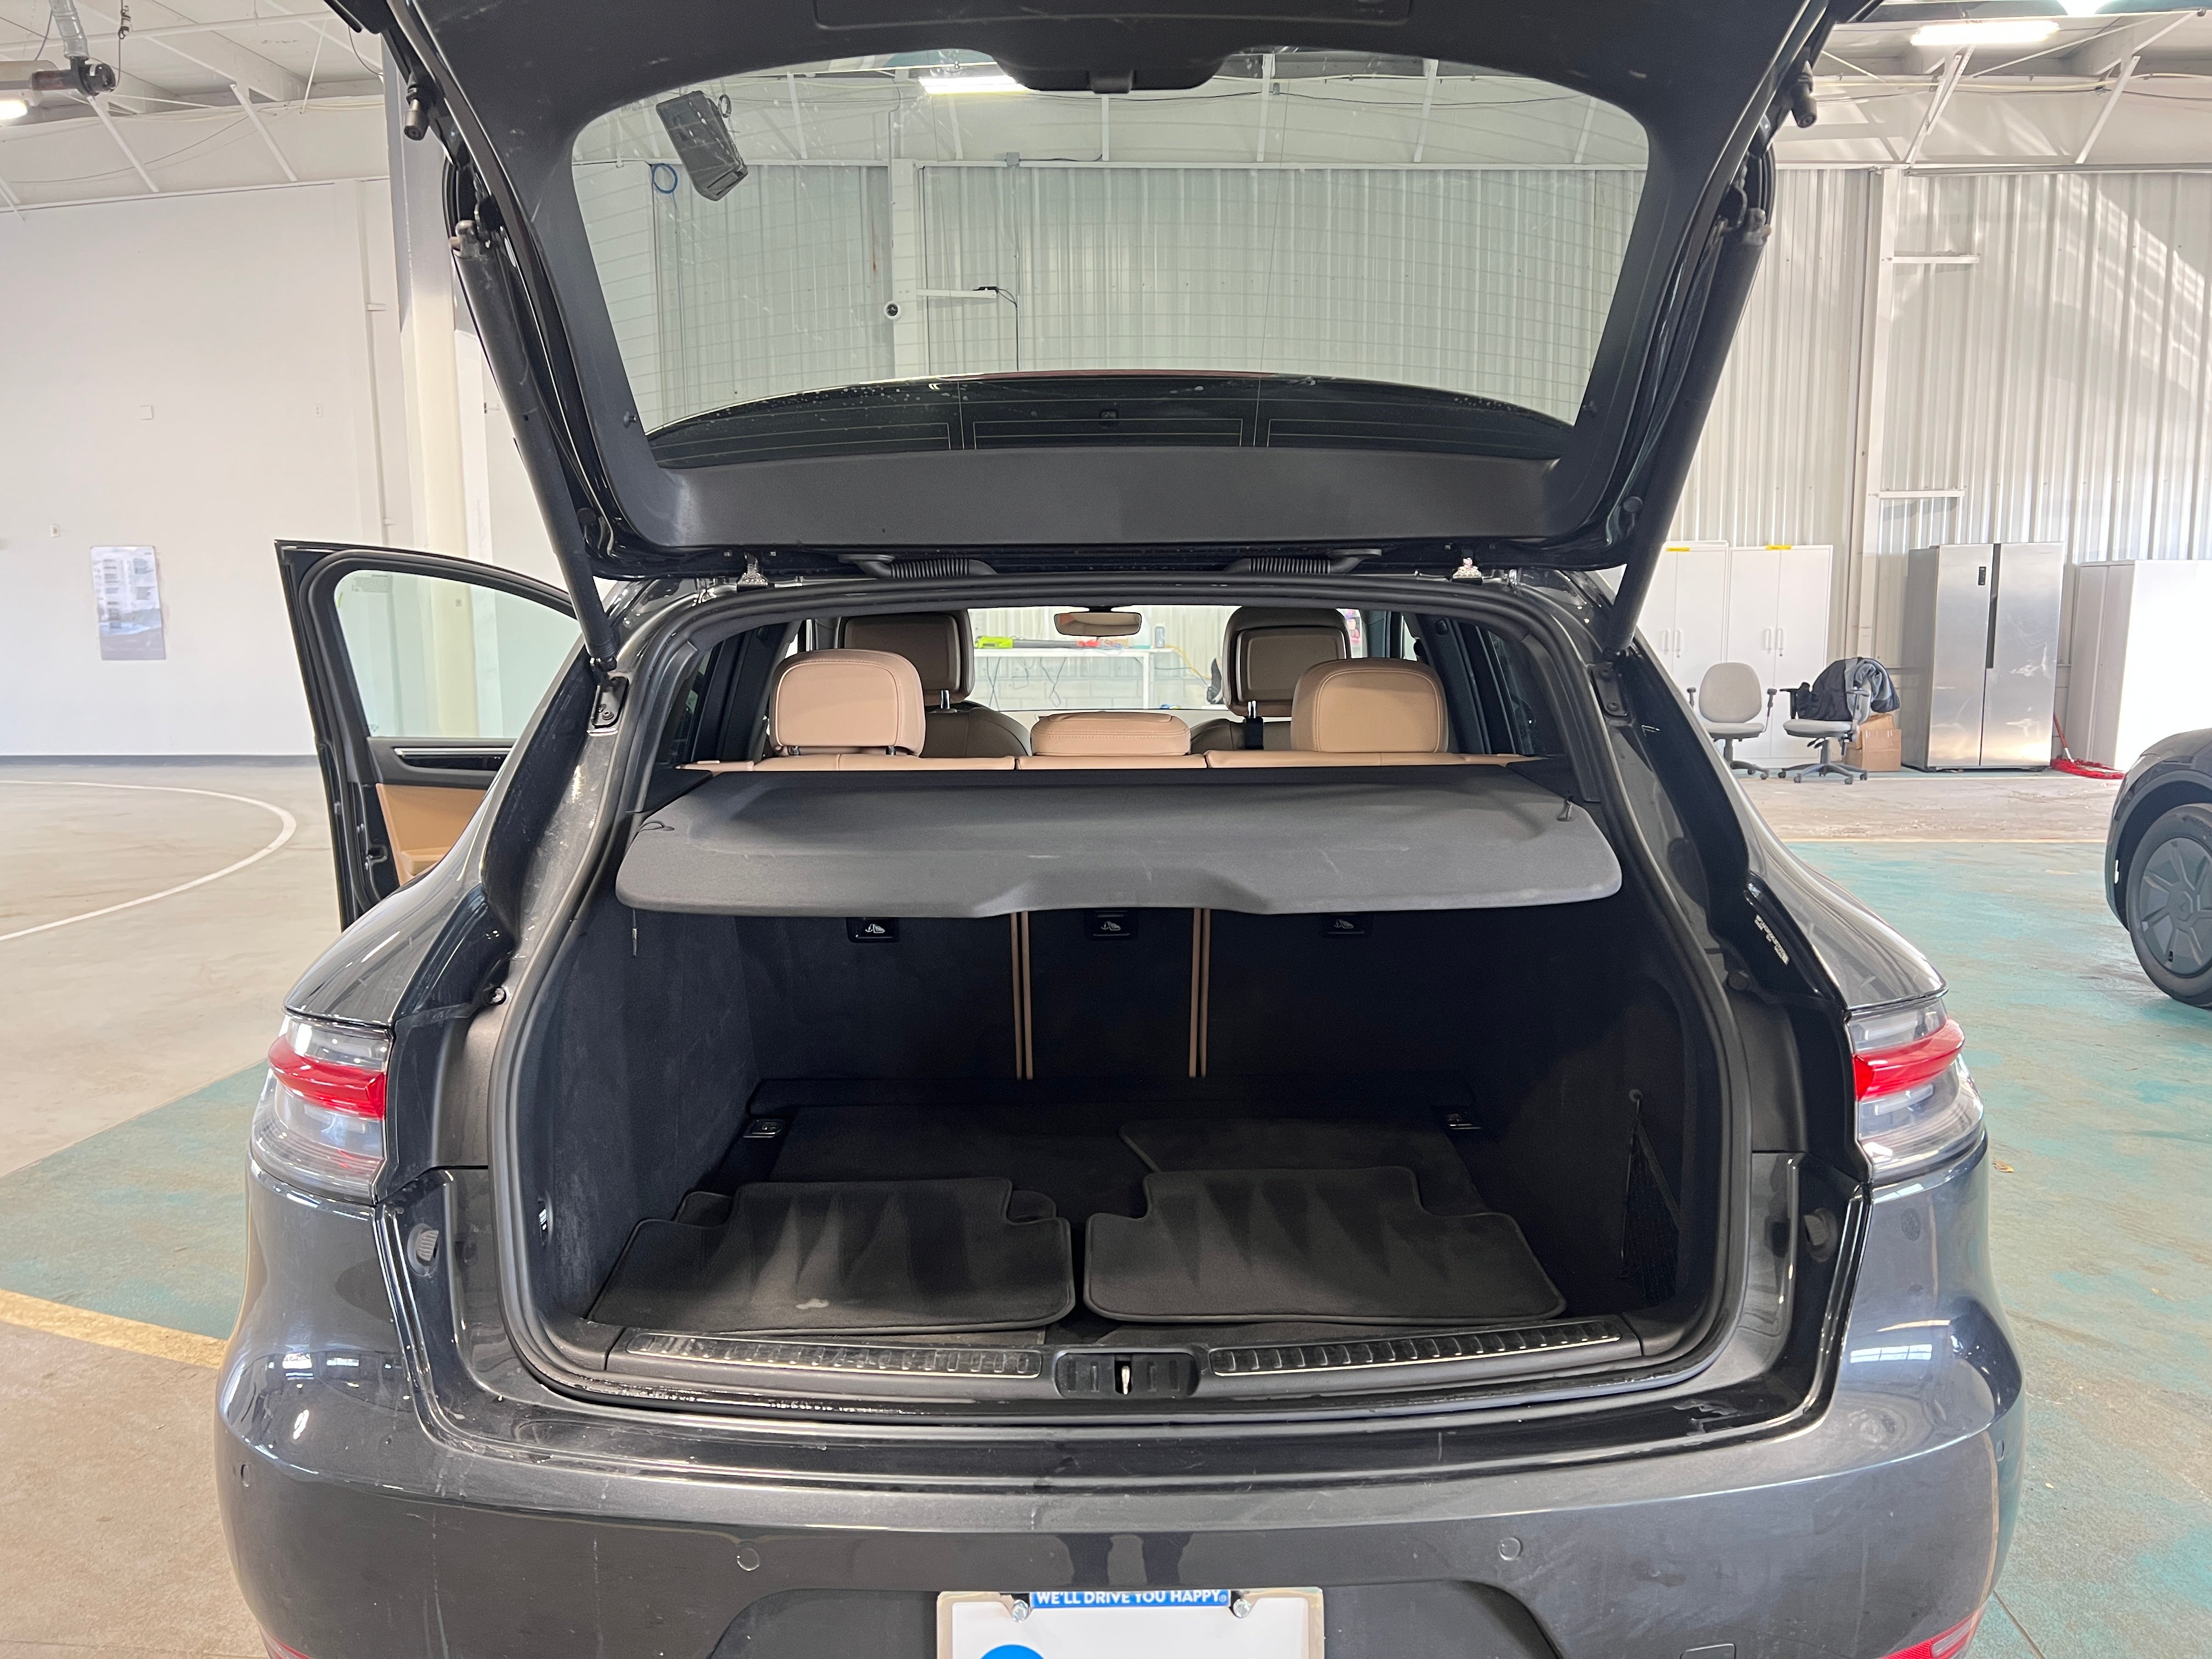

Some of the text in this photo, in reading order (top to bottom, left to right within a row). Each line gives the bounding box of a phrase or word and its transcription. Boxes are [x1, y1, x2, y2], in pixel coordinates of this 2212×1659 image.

[1036, 1592, 1080, 1604] WE'LL
[1084, 1592, 1130, 1604] DRIVE
[1135, 1590, 1165, 1603] YOU
